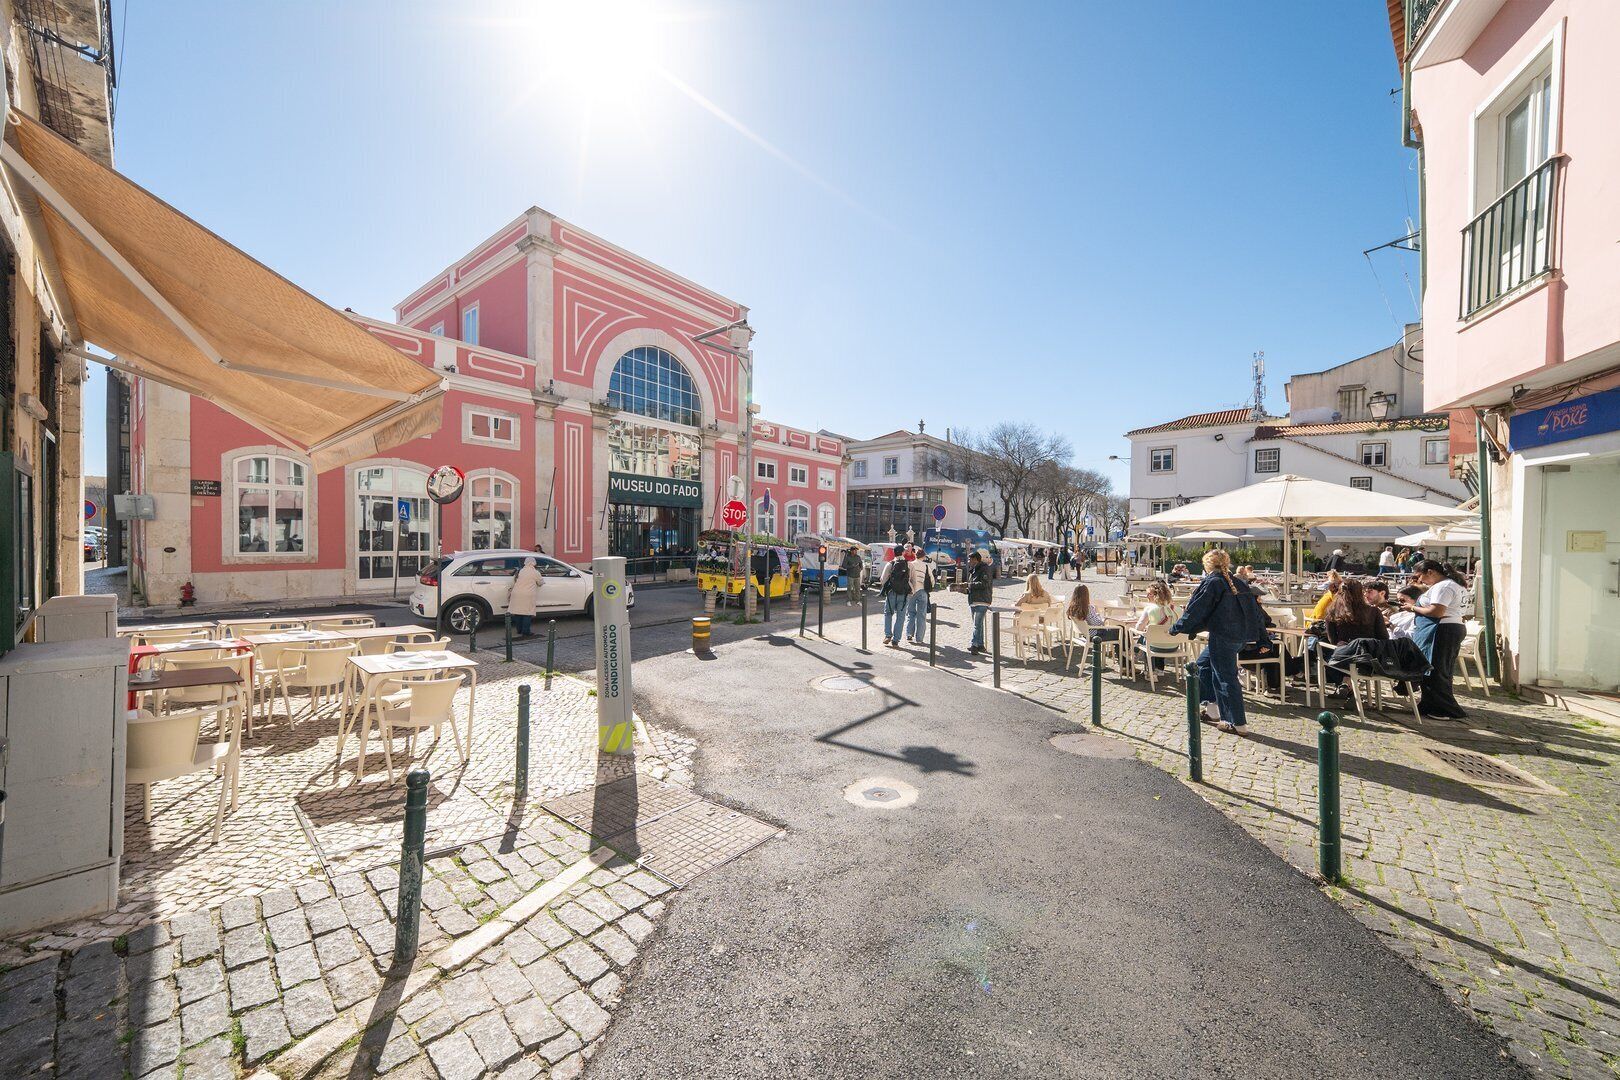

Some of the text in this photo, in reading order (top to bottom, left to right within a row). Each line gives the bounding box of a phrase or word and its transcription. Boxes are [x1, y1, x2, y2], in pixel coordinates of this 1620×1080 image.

[611, 478, 699, 497] MUSEU DO FADO
[723, 508, 747, 521] STOP
[609, 624, 619, 698] CONDICIONADO
